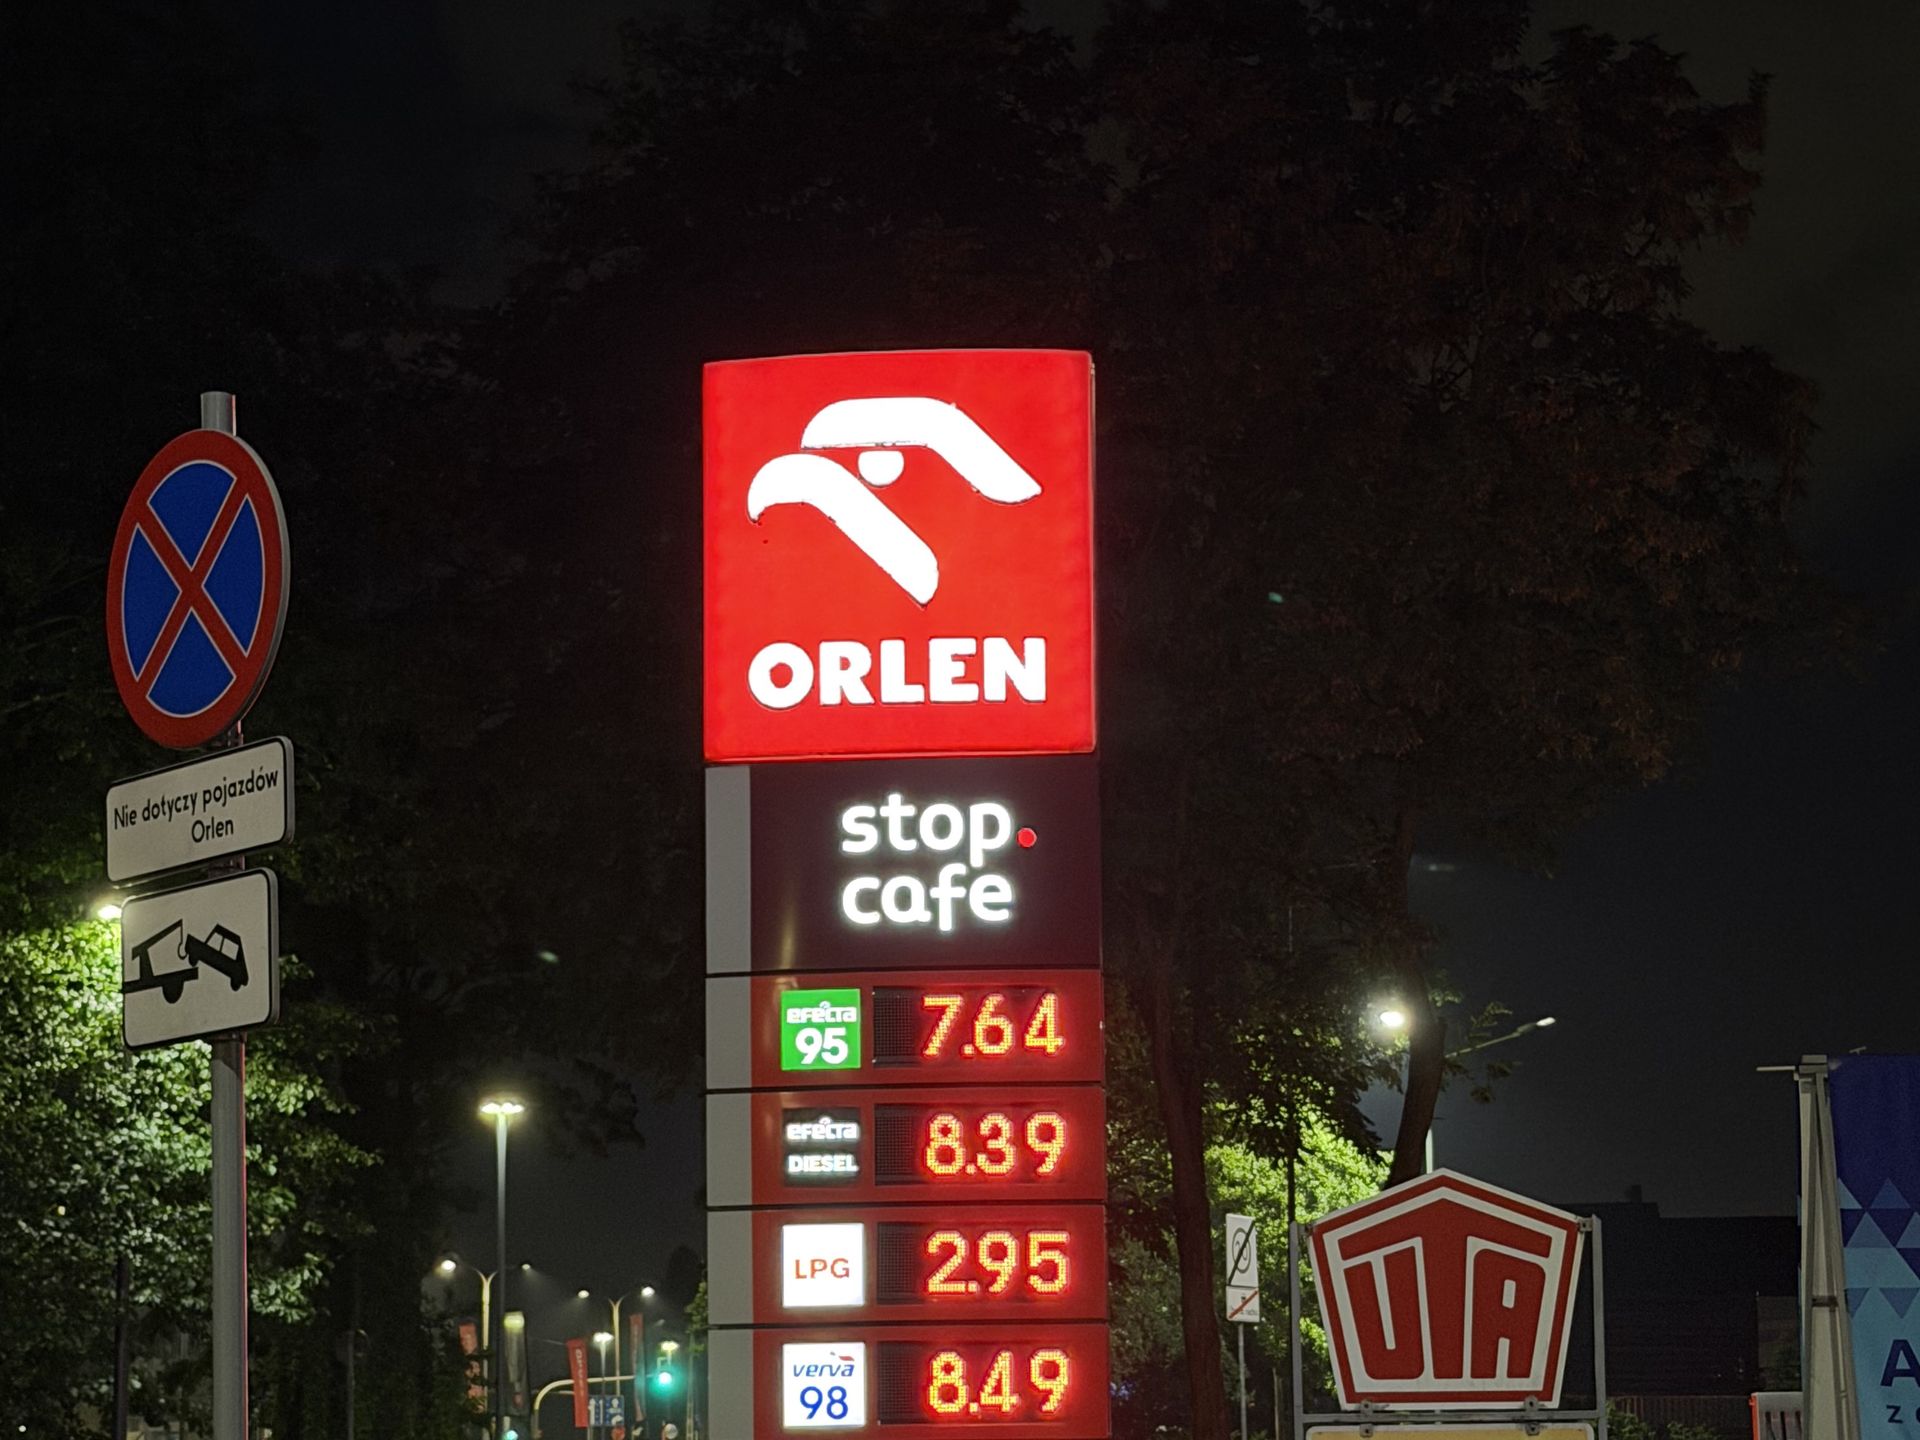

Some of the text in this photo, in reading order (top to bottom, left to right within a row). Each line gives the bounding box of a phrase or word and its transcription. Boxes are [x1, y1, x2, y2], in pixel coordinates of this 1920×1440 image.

[748, 637, 1046, 710] ORLEN
[114, 766, 278, 830] Nie dotyczy pojazdów
[191, 816, 234, 843] Orlen
[841, 862, 1014, 932] cafe
[795, 1027, 849, 1065] 95
[922, 993, 1065, 1057] 7.64
[787, 1154, 859, 1173] DIESEL
[925, 1112, 1067, 1176] 8.39
[794, 1258, 851, 1280] LPG
[926, 1231, 1071, 1293] 2.95
[793, 1358, 855, 1378] verva
[928, 1350, 1072, 1414] 8.49
[799, 1386, 849, 1420] 98
